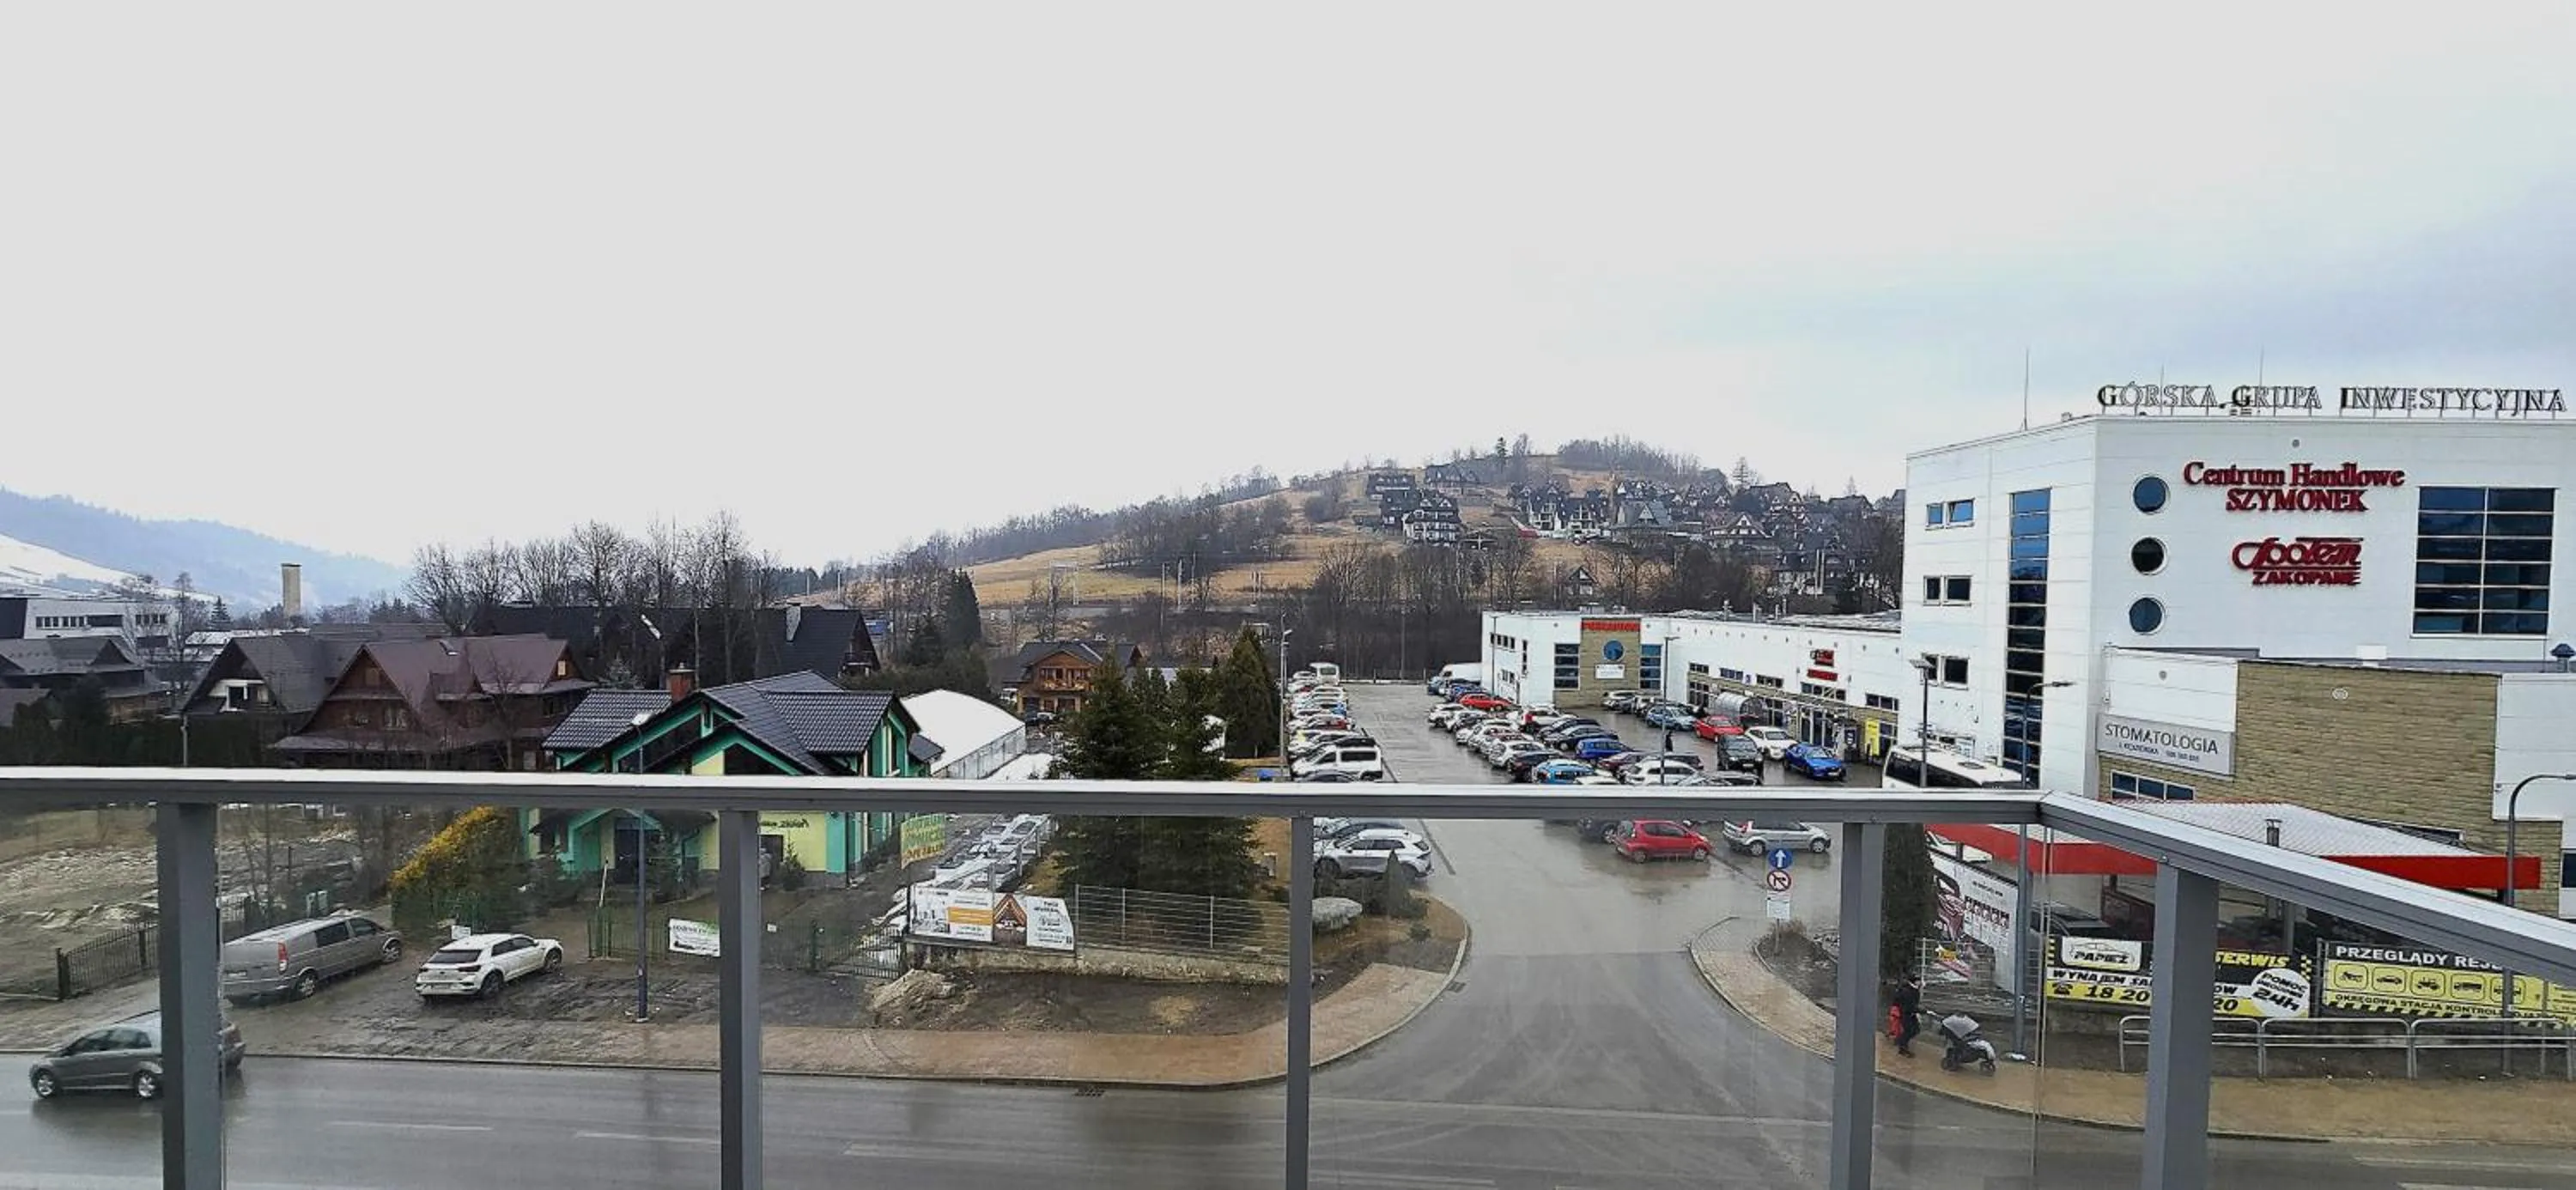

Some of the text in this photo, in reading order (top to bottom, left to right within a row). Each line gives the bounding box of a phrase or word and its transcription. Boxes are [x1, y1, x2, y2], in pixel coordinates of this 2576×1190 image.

[2097, 380, 2567, 416] GÓRSKA GRUPA INWESTYCYJNA
[2184, 461, 2406, 487] Centrum Handlowe
[2226, 489, 2369, 512] SZYMONEK
[2251, 571, 2361, 586] ZAKOPANE
[2105, 724, 2219, 755] STOMATOLOGIA
[2336, 945, 2448, 966] PRZEGLĄDY
[2053, 969, 2127, 984] WYNAJEM
[2262, 972, 2308, 993] POMOC
[2085, 985, 2115, 999] 18
[2119, 989, 2150, 1002] 20
[2400, 1000, 2443, 1011] STACJA
